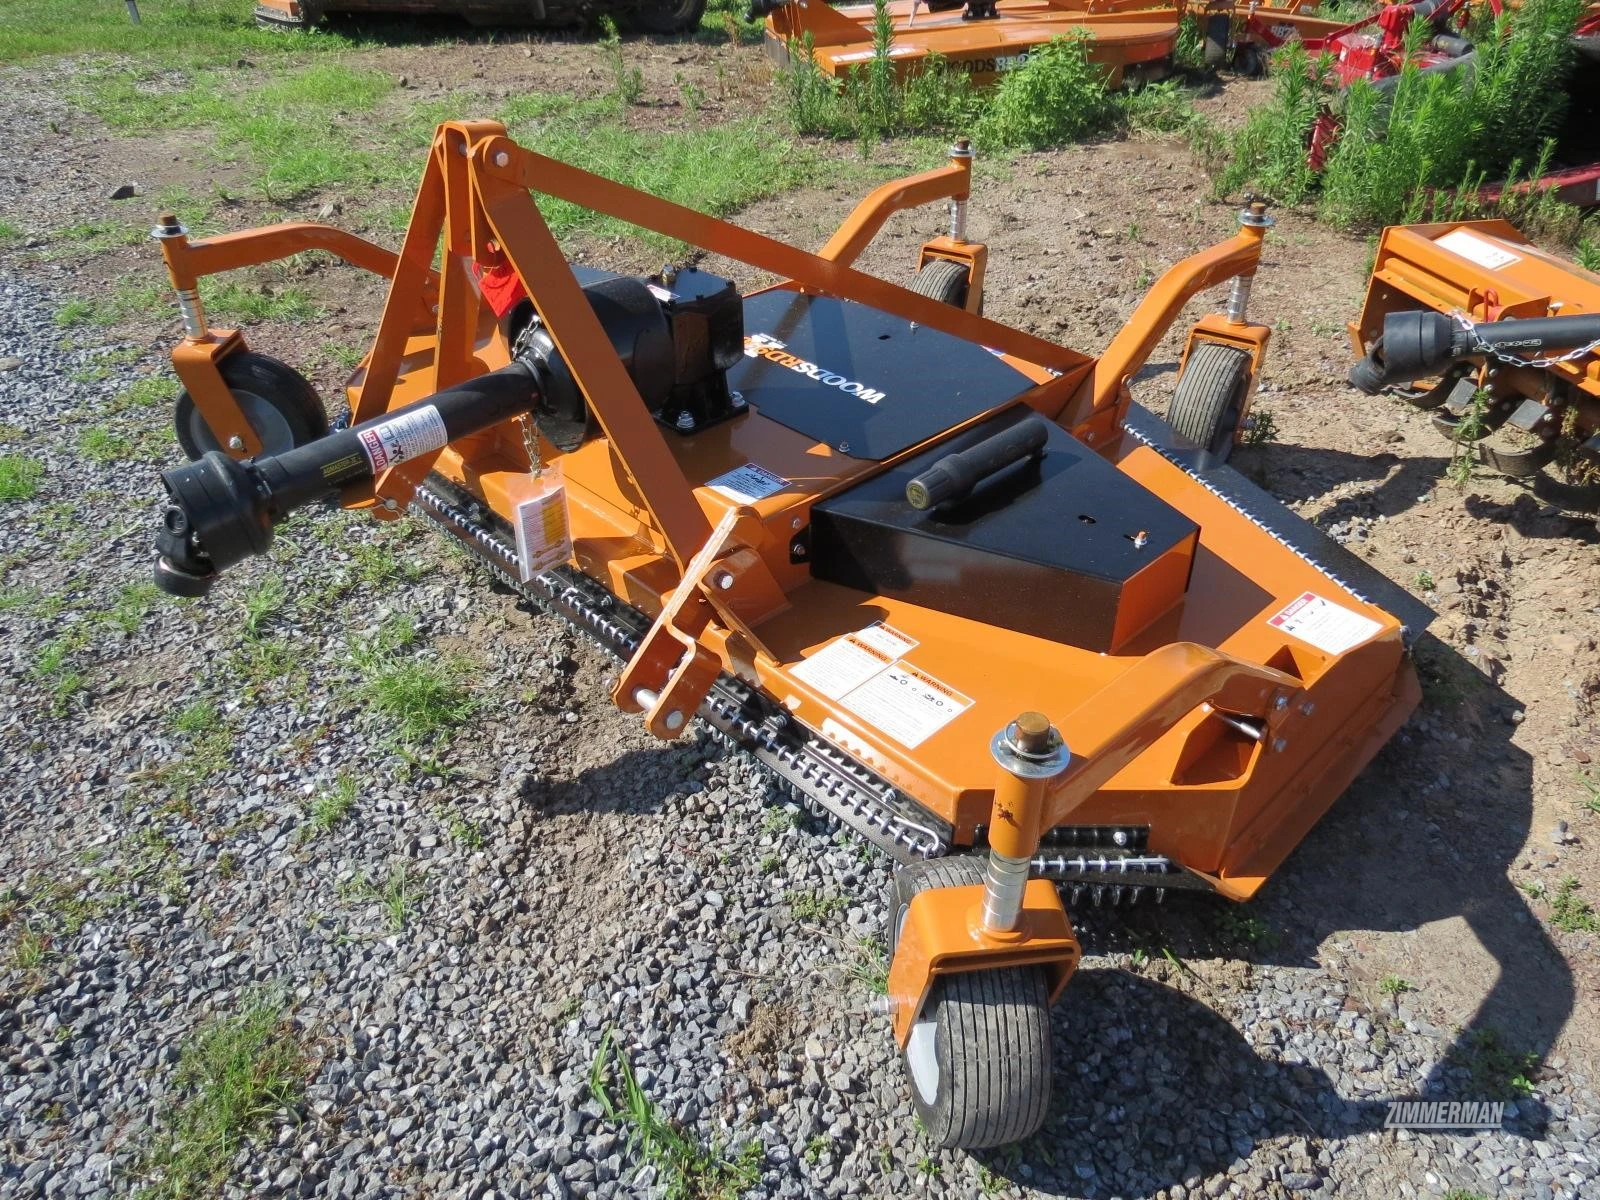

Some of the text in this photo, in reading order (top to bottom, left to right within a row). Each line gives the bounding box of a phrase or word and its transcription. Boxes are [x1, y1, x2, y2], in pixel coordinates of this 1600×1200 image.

[363, 430, 387, 468] DANGER
[884, 625, 912, 644] WARNING
[857, 641, 888, 661] WARNING
[920, 671, 954, 697] WARNING
